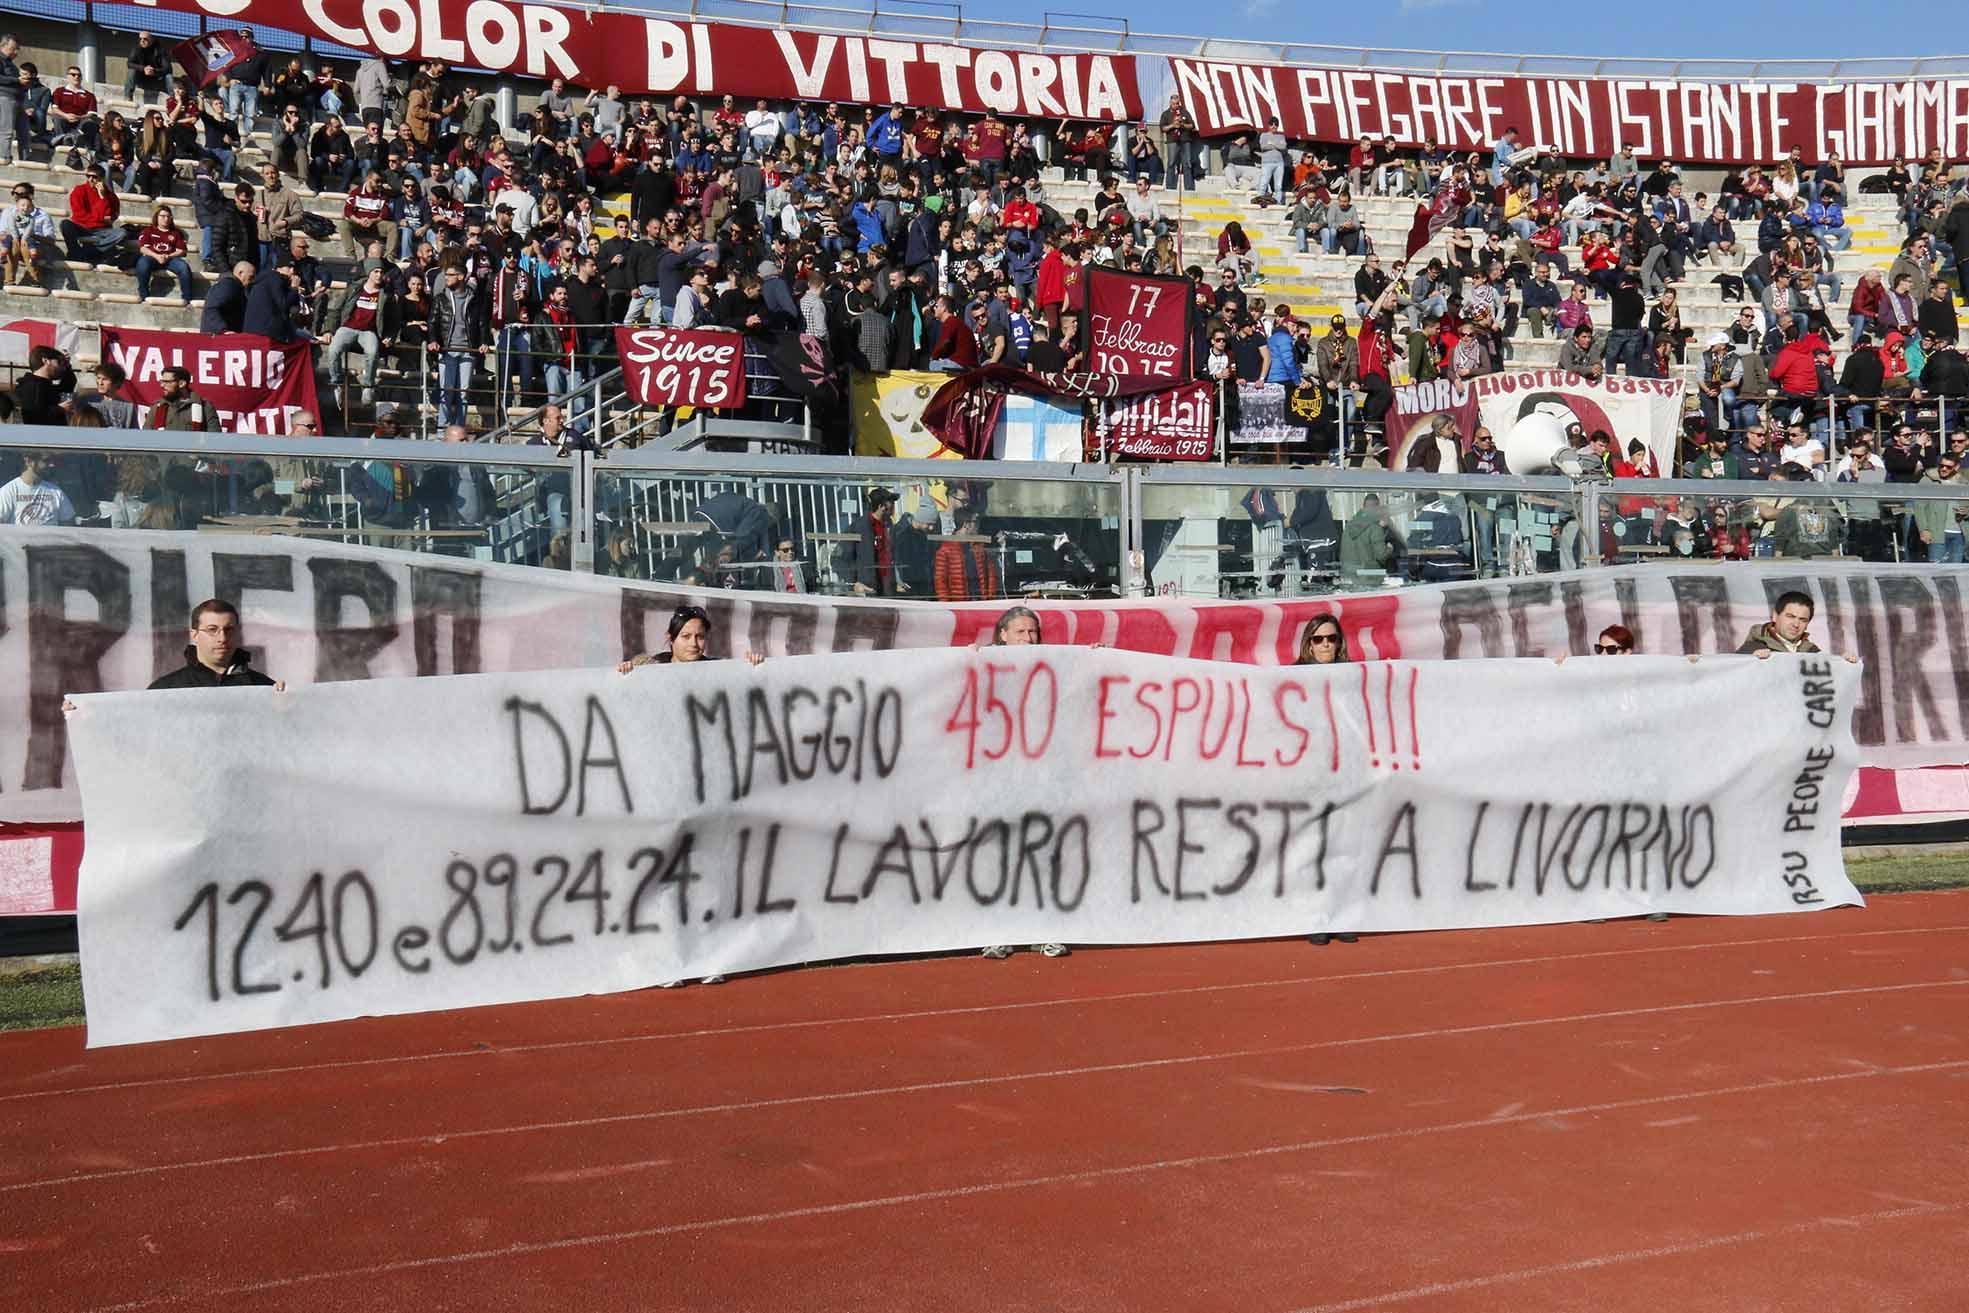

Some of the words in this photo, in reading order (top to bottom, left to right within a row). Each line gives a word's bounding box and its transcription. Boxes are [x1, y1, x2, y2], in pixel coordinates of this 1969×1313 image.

[306, 0, 580, 80] COLOR
[645, 18, 714, 91] DI
[772, 29, 1128, 121] VITTORIA
[1174, 58, 1282, 130] NON
[1297, 69, 1505, 148] PIEGARE
[1607, 80, 1798, 160] ISTANTE
[1091, 314, 1178, 357] Febbraio
[1128, 284, 1162, 318] 17
[627, 330, 736, 365] Since
[639, 364, 730, 404] 1915
[1800, 659, 1837, 729] CARE
[504, 692, 635, 816] DA
[685, 678, 904, 803] MAGGIO
[944, 659, 1059, 771] 450
[1784, 744, 1835, 833] PEOPLE
[732, 823, 797, 920] IL
[824, 811, 1090, 912] LAVORO
[1131, 797, 1336, 904] RESTI
[1370, 800, 1423, 900] A
[1465, 800, 1718, 896] LIVORNO
[1782, 850, 1825, 905] RSU
